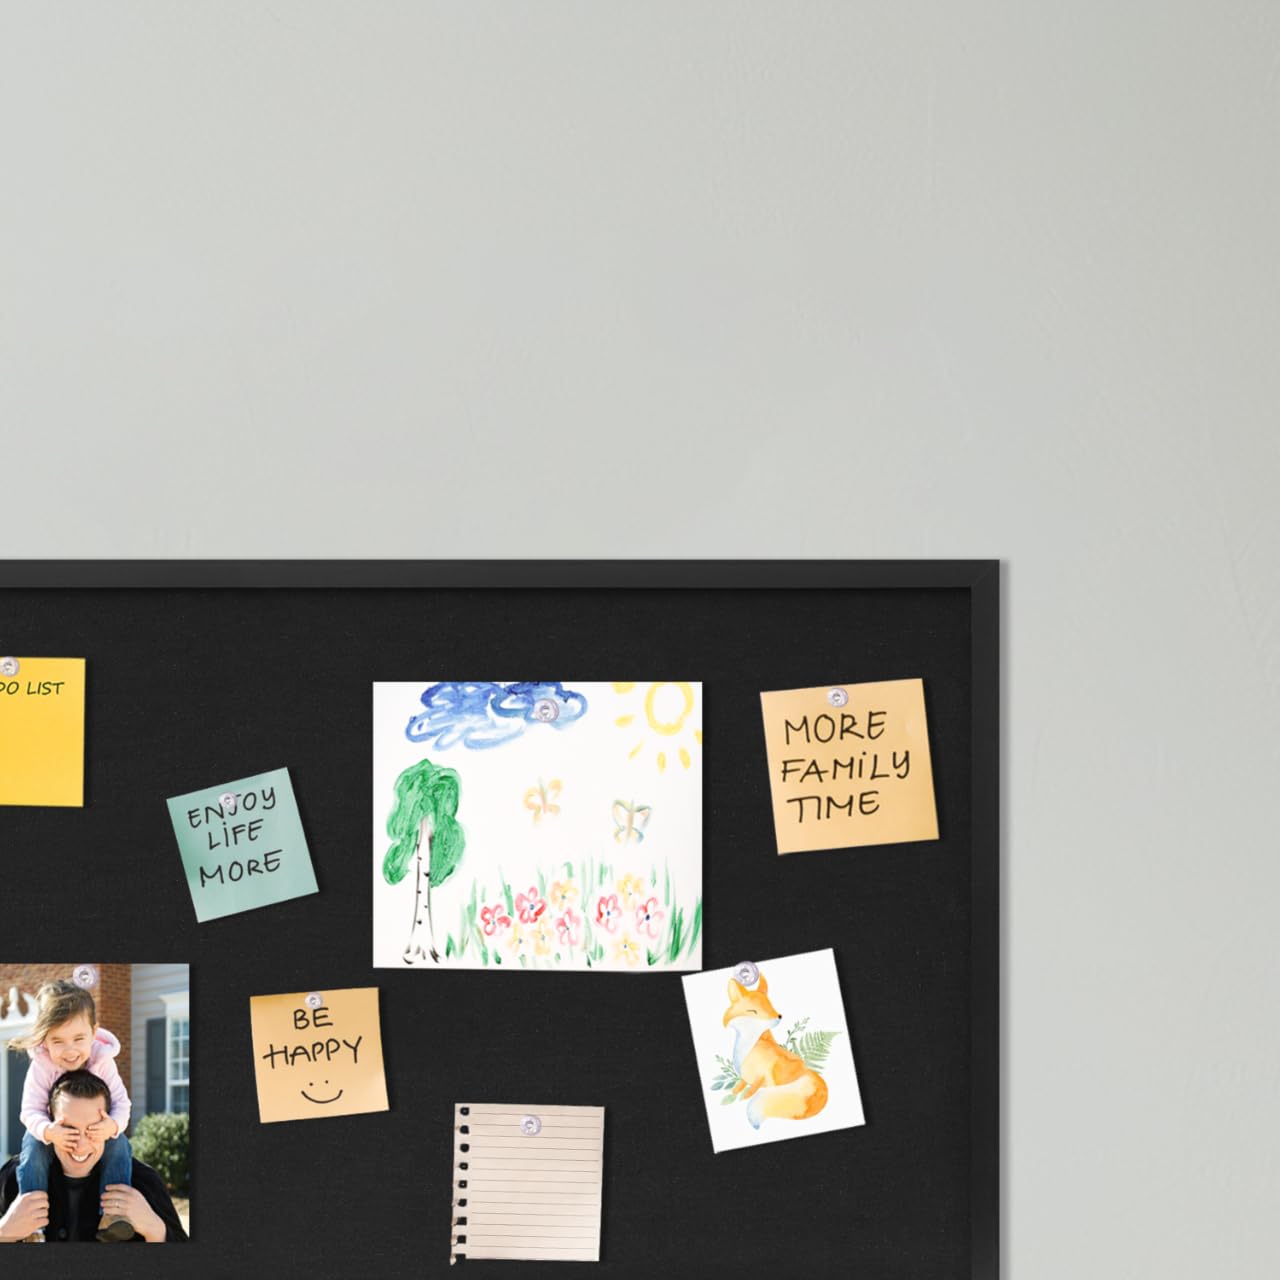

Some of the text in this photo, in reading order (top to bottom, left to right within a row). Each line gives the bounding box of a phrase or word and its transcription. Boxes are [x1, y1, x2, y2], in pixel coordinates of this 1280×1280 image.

[27, 681, 65, 695] LIST
[784, 710, 887, 745] MORE
[187, 786, 276, 828] ENJOY
[786, 790, 880, 823] TIME
[199, 849, 283, 888] MORE
[293, 1007, 333, 1030] BE
[262, 1035, 362, 1069] HAPPY
